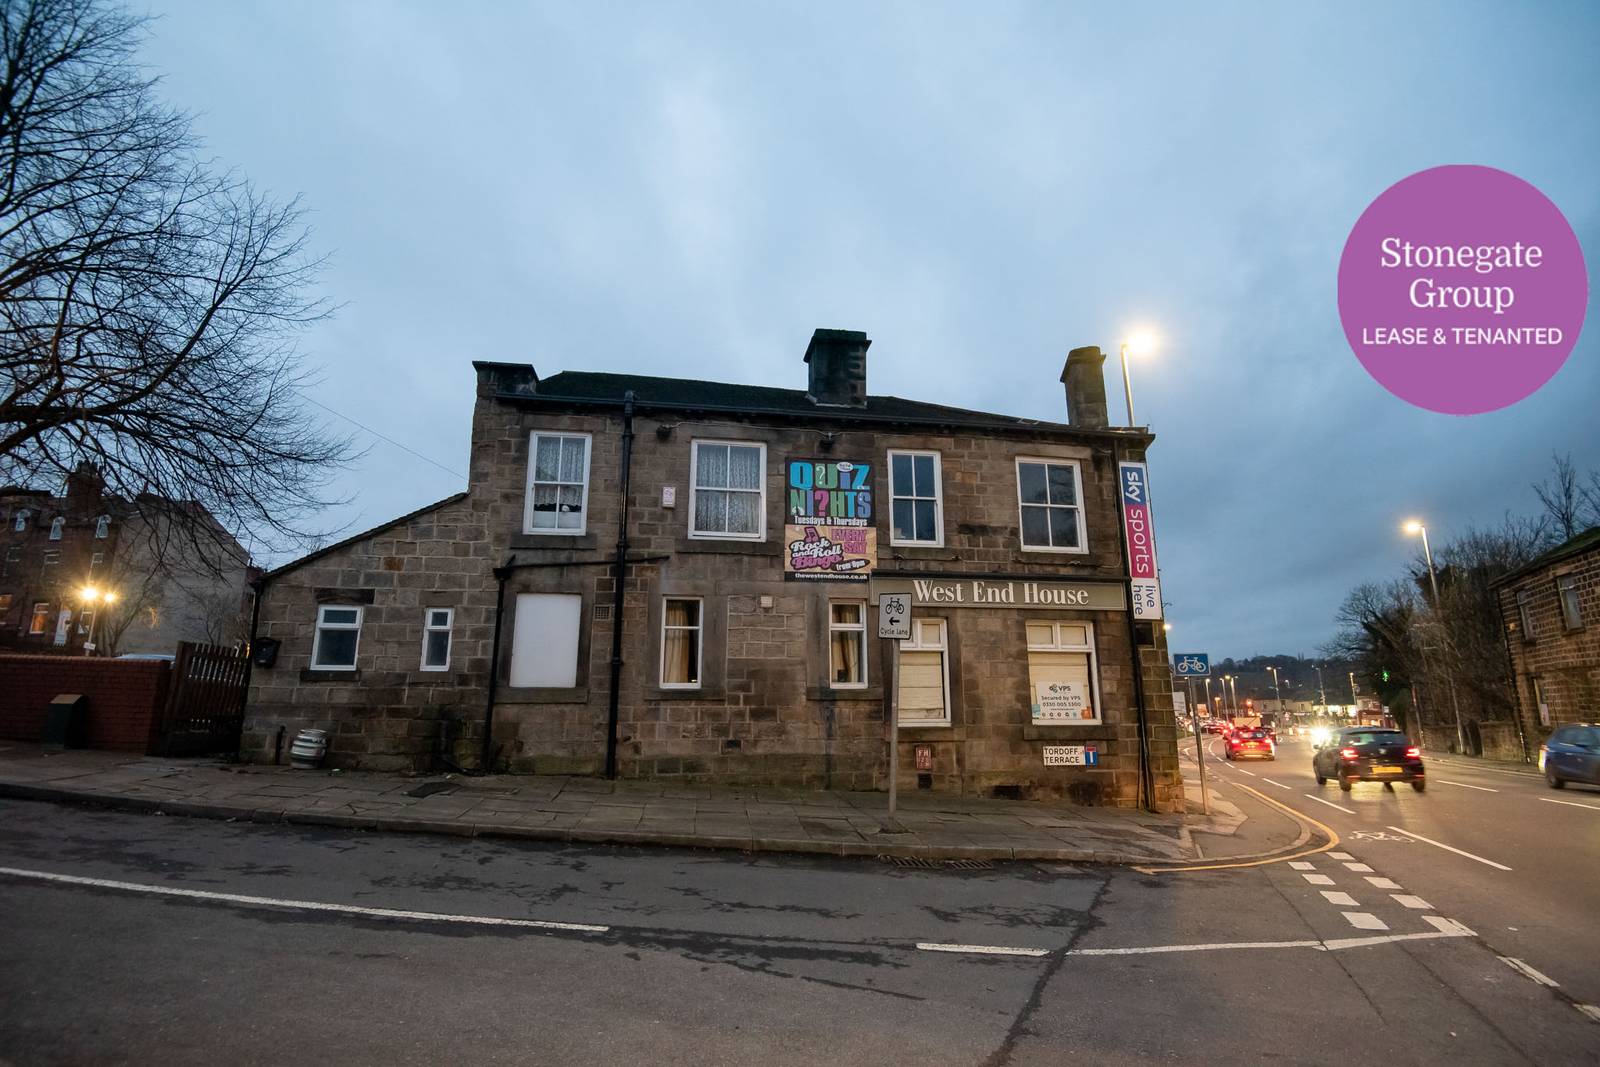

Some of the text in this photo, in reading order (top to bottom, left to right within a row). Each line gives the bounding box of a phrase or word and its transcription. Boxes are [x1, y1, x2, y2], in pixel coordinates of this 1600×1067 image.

[794, 515, 868, 527] Tuesdays & Thursdays
[1125, 471, 1150, 574] sky sports
[791, 538, 830, 552] Rock
[792, 544, 842, 559] and Roll
[792, 555, 843, 570] Bingo
[913, 580, 1089, 605] West End House
[1133, 584, 1144, 615] here
[1145, 585, 1156, 608] live
[881, 628, 895, 636] Cycle
[1044, 747, 1078, 755] TORDOFF
[1044, 756, 1080, 764] TERRACE
